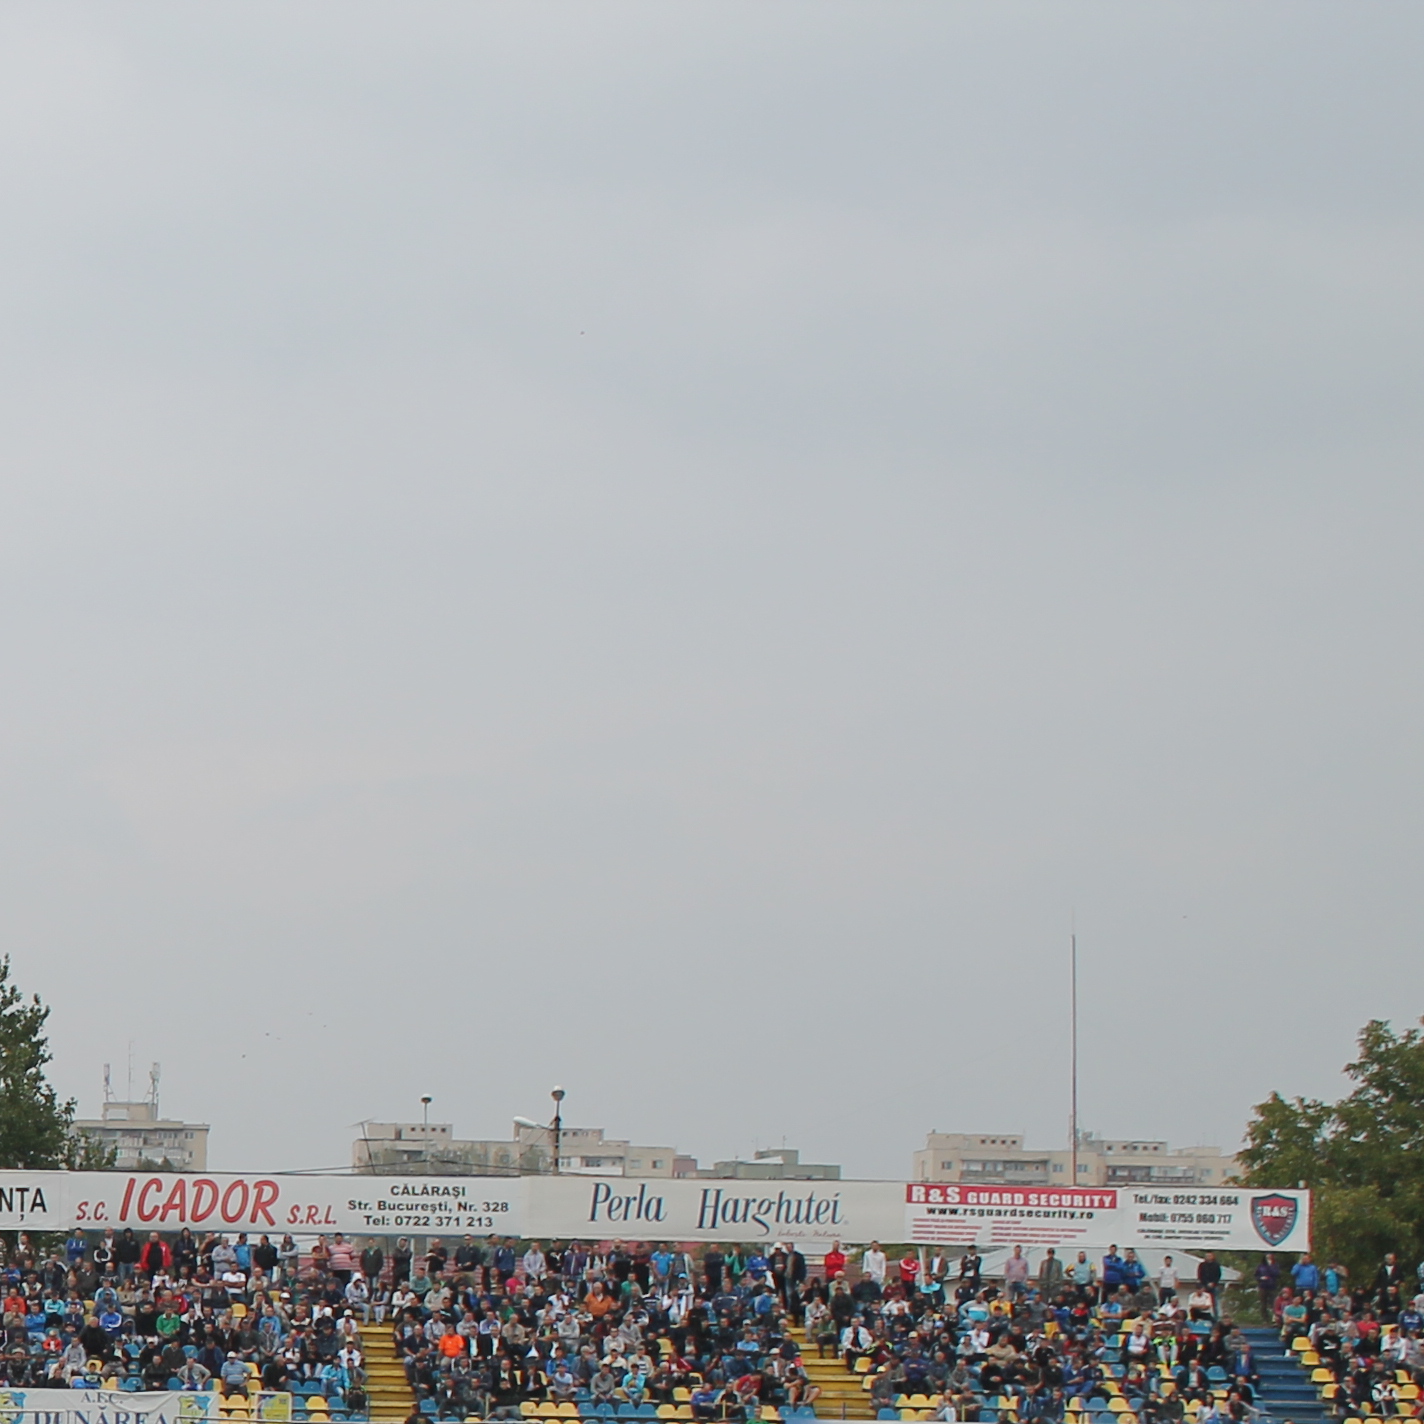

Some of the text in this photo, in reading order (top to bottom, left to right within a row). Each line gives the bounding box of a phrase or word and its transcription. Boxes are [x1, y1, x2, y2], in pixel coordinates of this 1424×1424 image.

[389, 1182, 467, 1200] CĂLĂRAȘI
[966, 1191, 1025, 1206] GUARD
[1028, 1193, 1114, 1209] SECURITY
[76, 1178, 338, 1227] S.C. ICADOR S.R.L.
[347, 1199, 373, 1212] Str.
[457, 1201, 478, 1213] Nr.
[482, 1201, 510, 1214] 328
[588, 1182, 845, 1237] Perla Harghitei
[363, 1215, 494, 1229] Tel: 0722 371 213
[926, 1206, 1094, 1220] www.rsguardsecurity.ro
